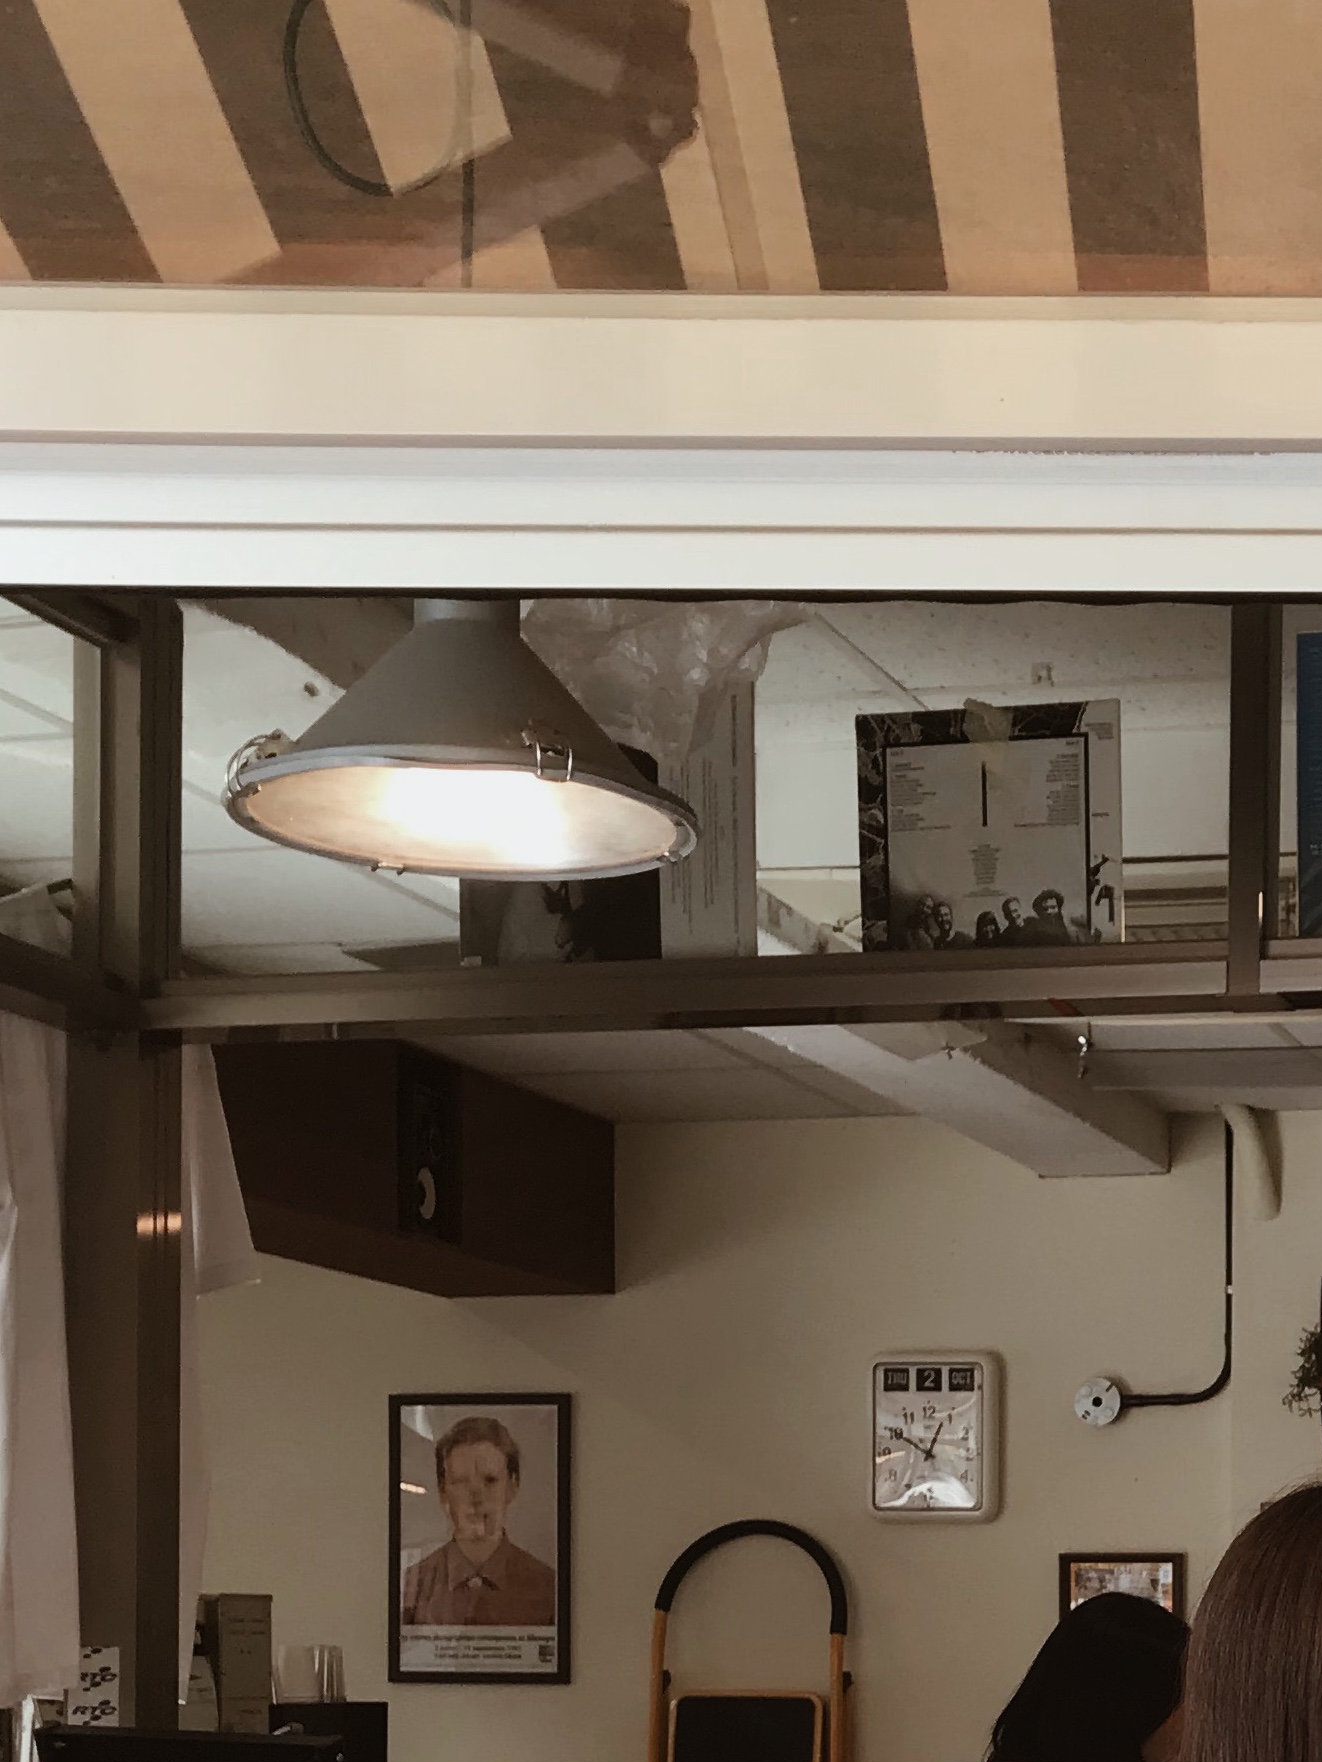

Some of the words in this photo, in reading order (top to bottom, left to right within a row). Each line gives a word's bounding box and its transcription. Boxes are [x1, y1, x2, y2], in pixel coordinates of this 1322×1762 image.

[923, 1370, 936, 1387] 2
[951, 1371, 972, 1384] OCT
[902, 1411, 915, 1425] 11
[922, 1405, 937, 1419] 12
[947, 1412, 953, 1425] 1
[888, 1427, 904, 1440] 10
[960, 1426, 970, 1441] 2
